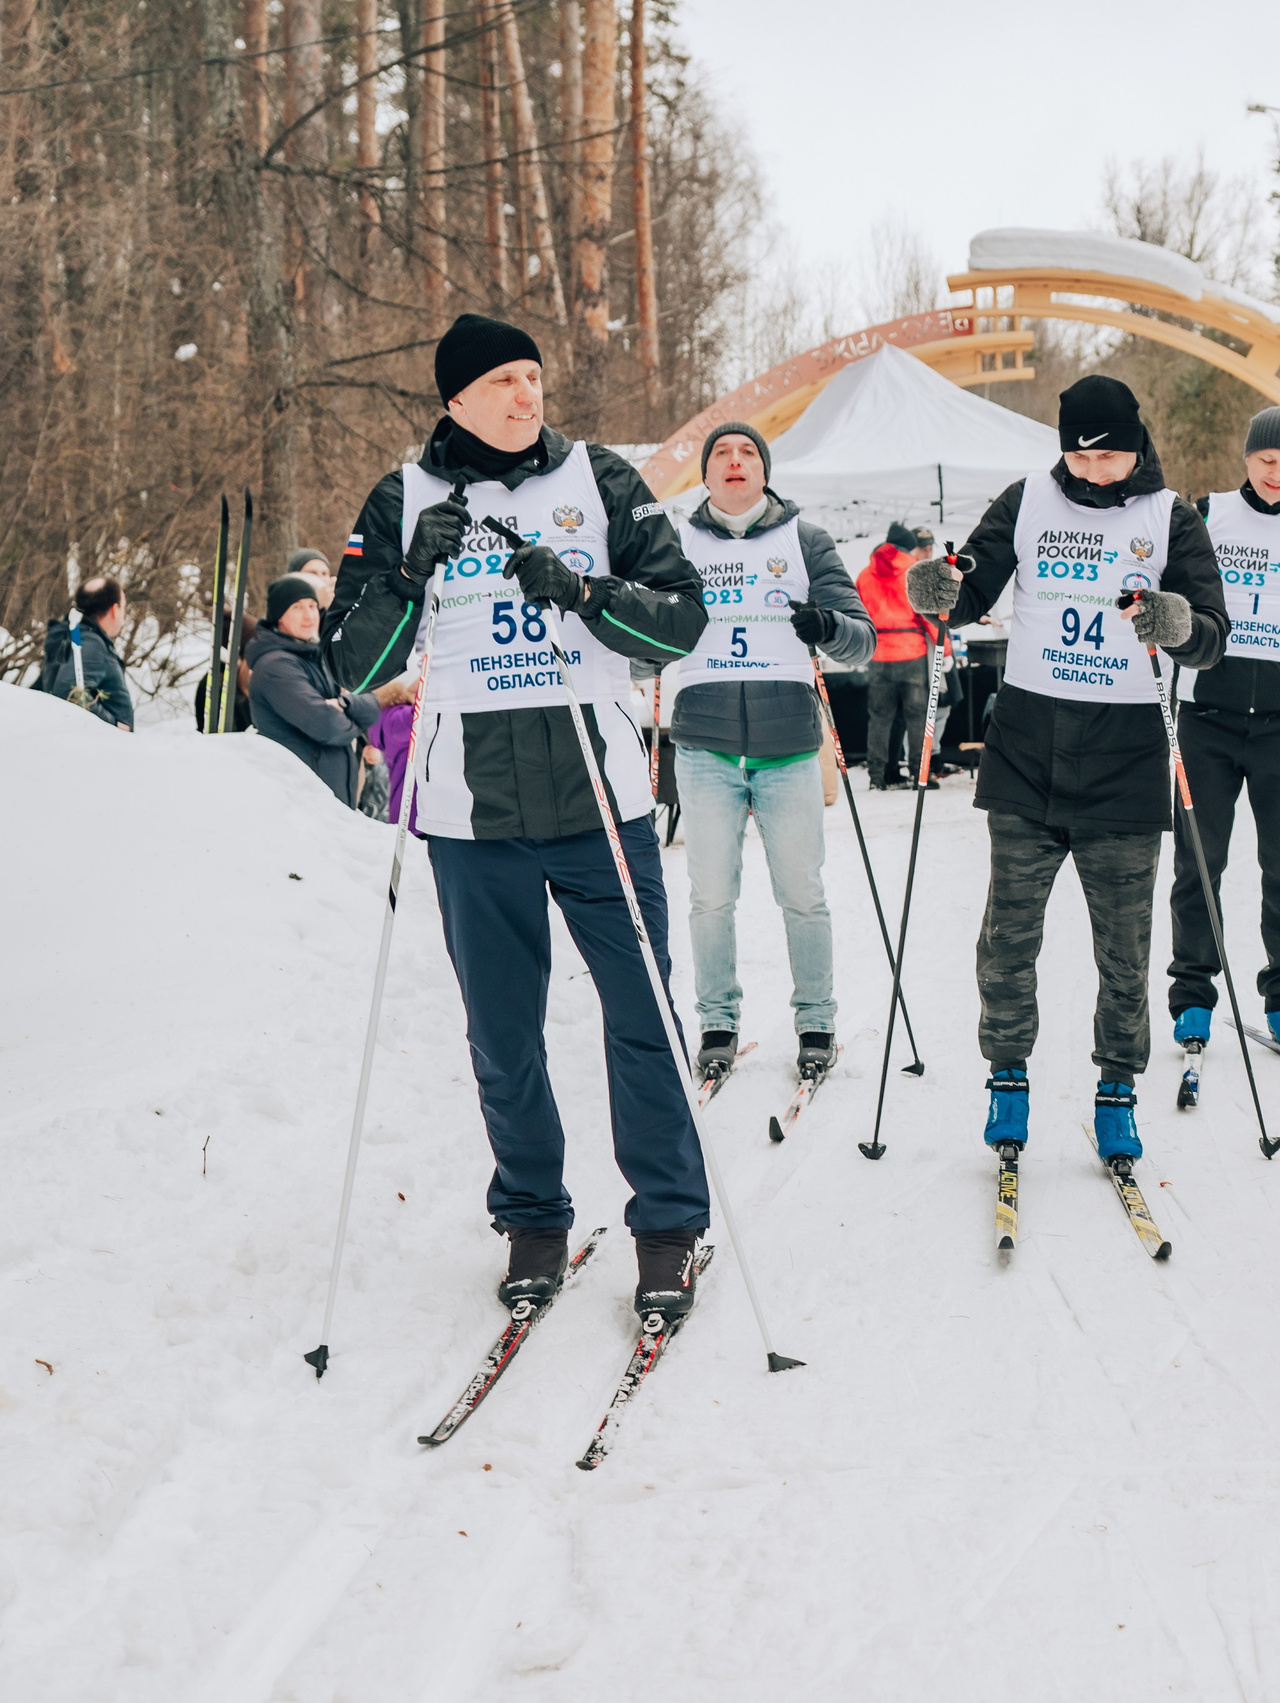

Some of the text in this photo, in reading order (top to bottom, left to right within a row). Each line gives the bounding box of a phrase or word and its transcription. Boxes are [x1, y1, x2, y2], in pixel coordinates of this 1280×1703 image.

[1037, 530, 1104, 547] ЛЫЖНЯ
[1037, 545, 1102, 562] РОССИИ
[1037, 560, 1099, 582] 2023
[441, 588, 523, 609] СПОРТ НОР
[702, 589, 743, 605] 023
[1037, 591, 1114, 607] СПОРТ НОРМА
[1249, 593, 1260, 615] 1
[492, 601, 547, 645] 58
[1060, 607, 1105, 651] 94
[731, 627, 748, 658] 5
[1230, 634, 1280, 648] ОБЛАСТЬ
[1042, 648, 1129, 670] ПЕНЗЕНСКАЯ
[1052, 667, 1114, 686] ОБЛАСТЬ
[1156, 682, 1177, 748] BRADOS
[1001, 1170, 1018, 1200] ACTIVE
